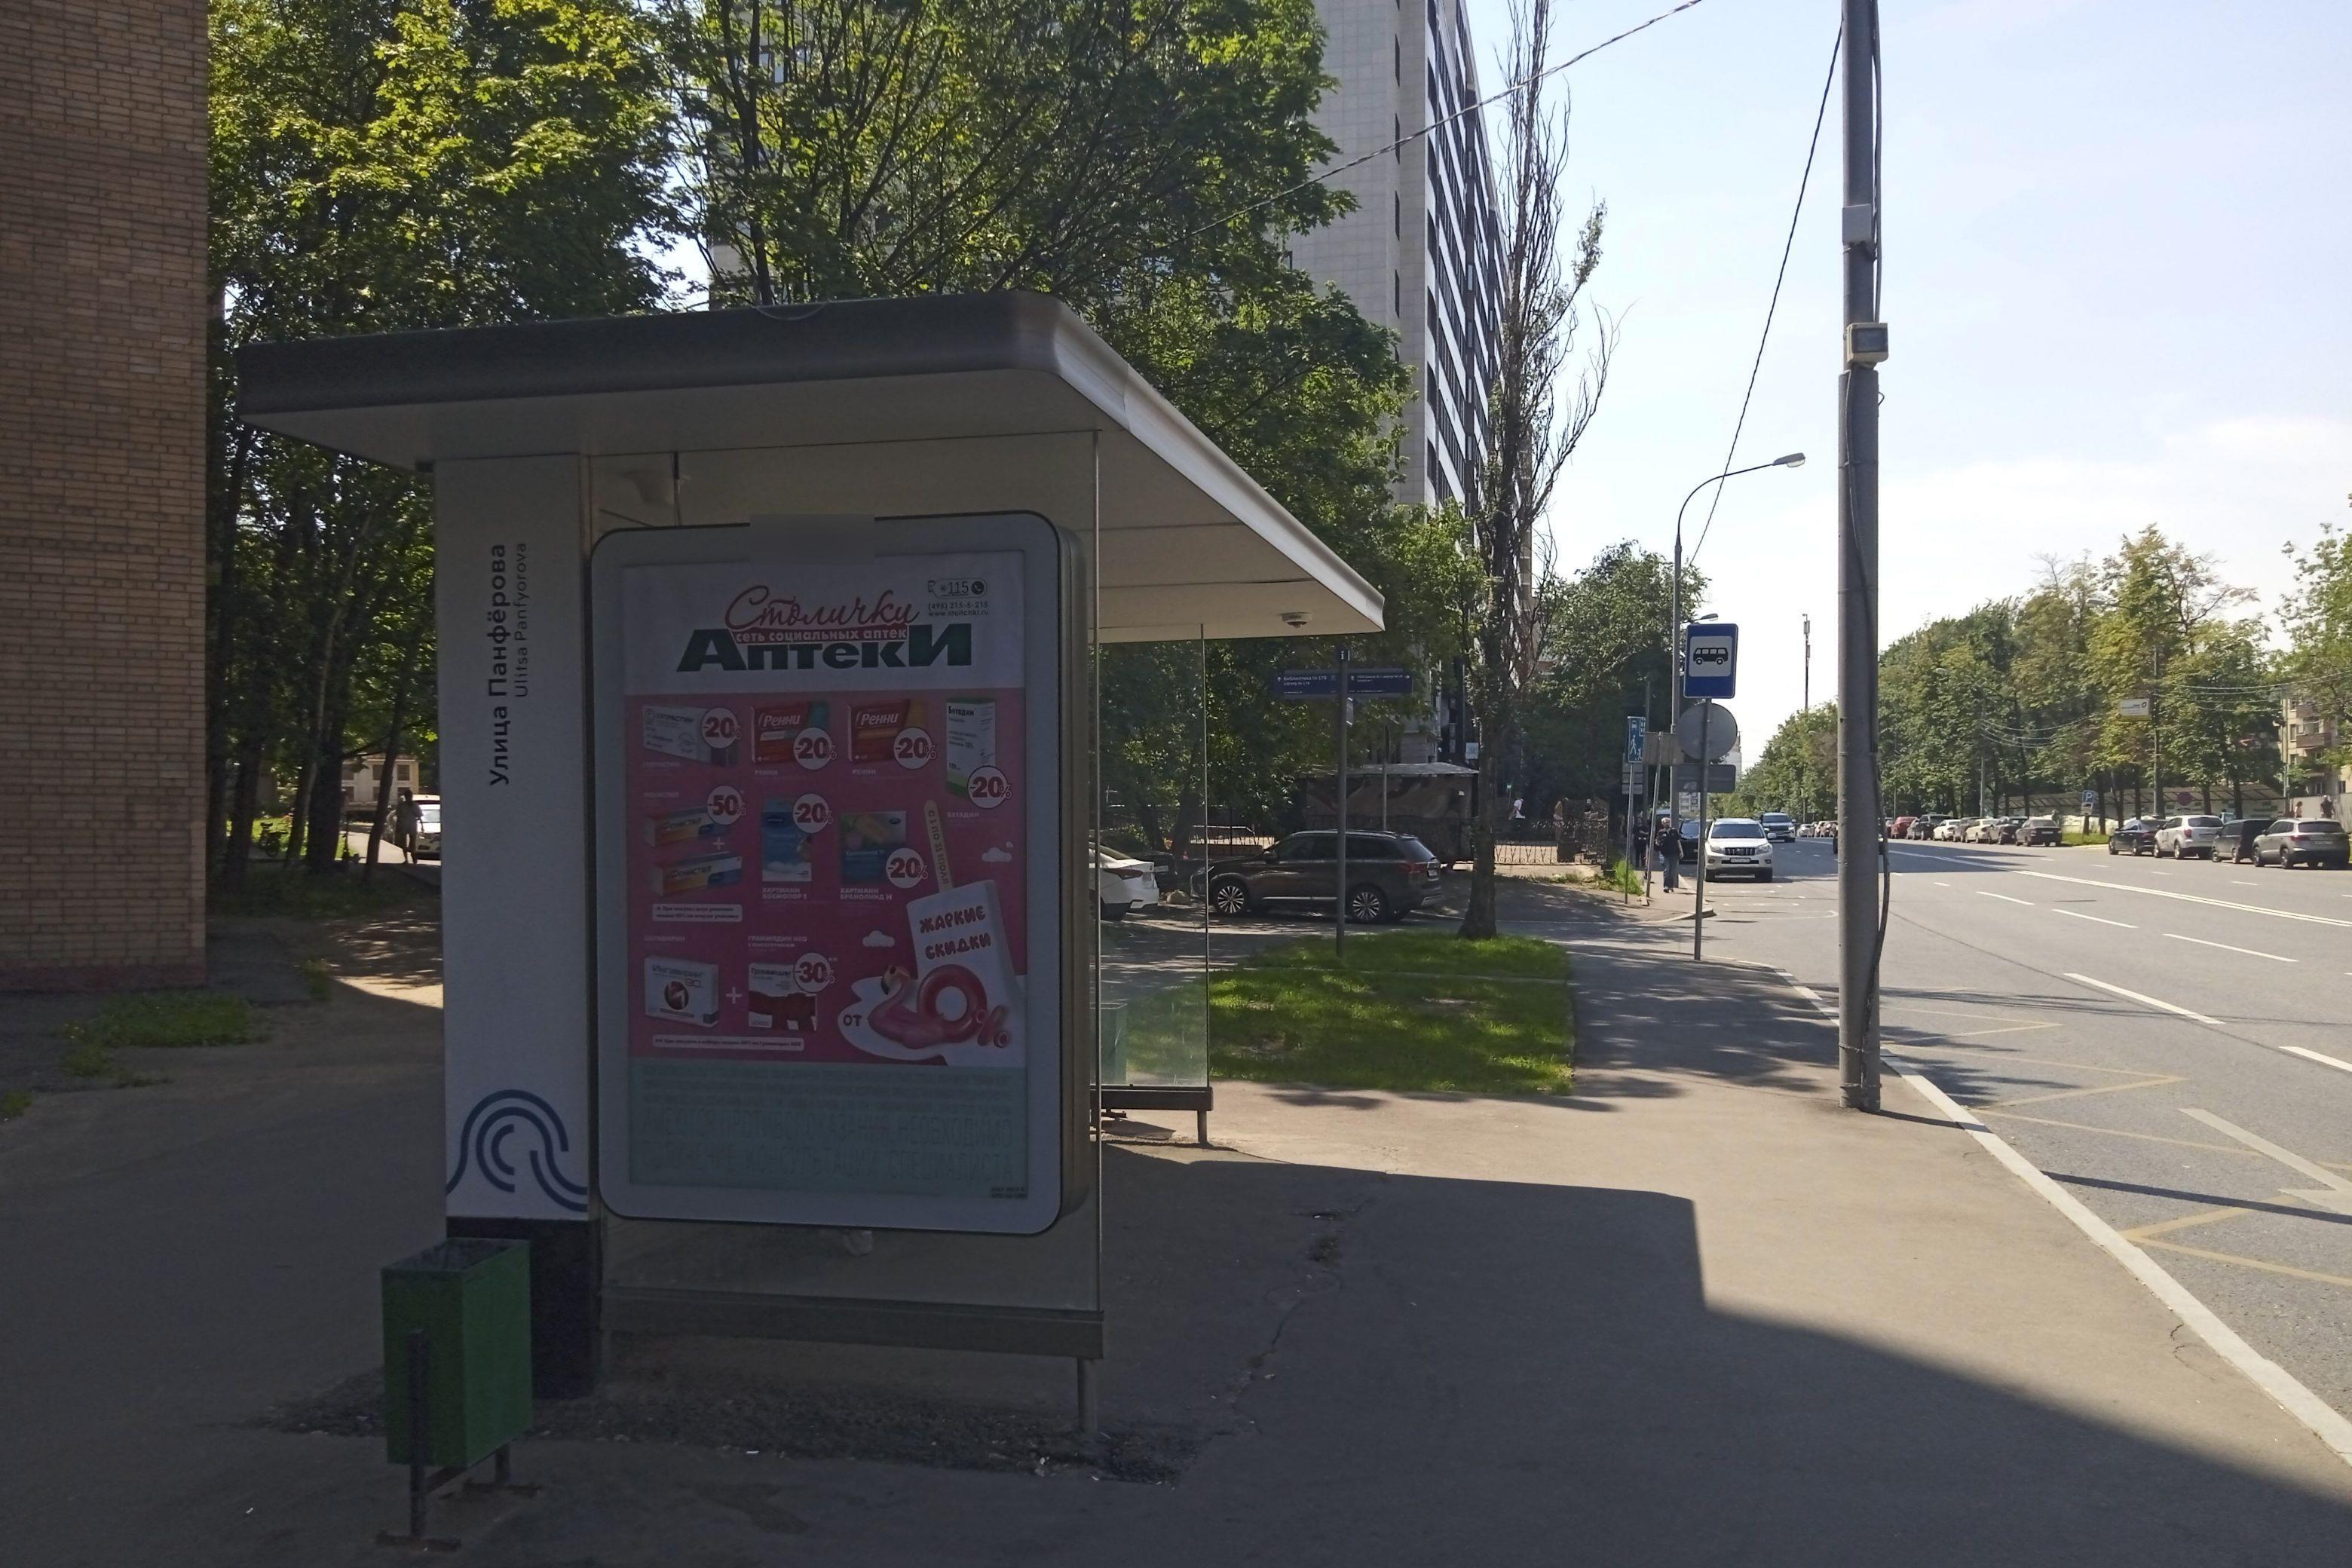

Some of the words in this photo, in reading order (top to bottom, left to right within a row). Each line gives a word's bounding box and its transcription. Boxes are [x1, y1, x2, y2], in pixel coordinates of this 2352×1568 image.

[513, 541, 531, 642] Panfyorova
[724, 584, 920, 630] Столички
[486, 544, 512, 697] Панфёрова
[735, 632, 765, 643] сеть
[768, 629, 859, 643] социальных
[862, 627, 908, 641] аптек
[513, 646, 529, 698] Ulitsa
[703, 716, 743, 741] -20%
[763, 714, 801, 727] Ренни
[859, 712, 899, 726] Ренни
[489, 706, 510, 787] Улица
[795, 737, 838, 761] -20%
[895, 737, 937, 760] -20%
[969, 776, 1013, 800] -20%
[794, 803, 834, 825] -20%
[887, 857, 929, 880] -20%
[919, 905, 987, 935] ЖАРКИЕ
[925, 932, 991, 960] СКИДКИ
